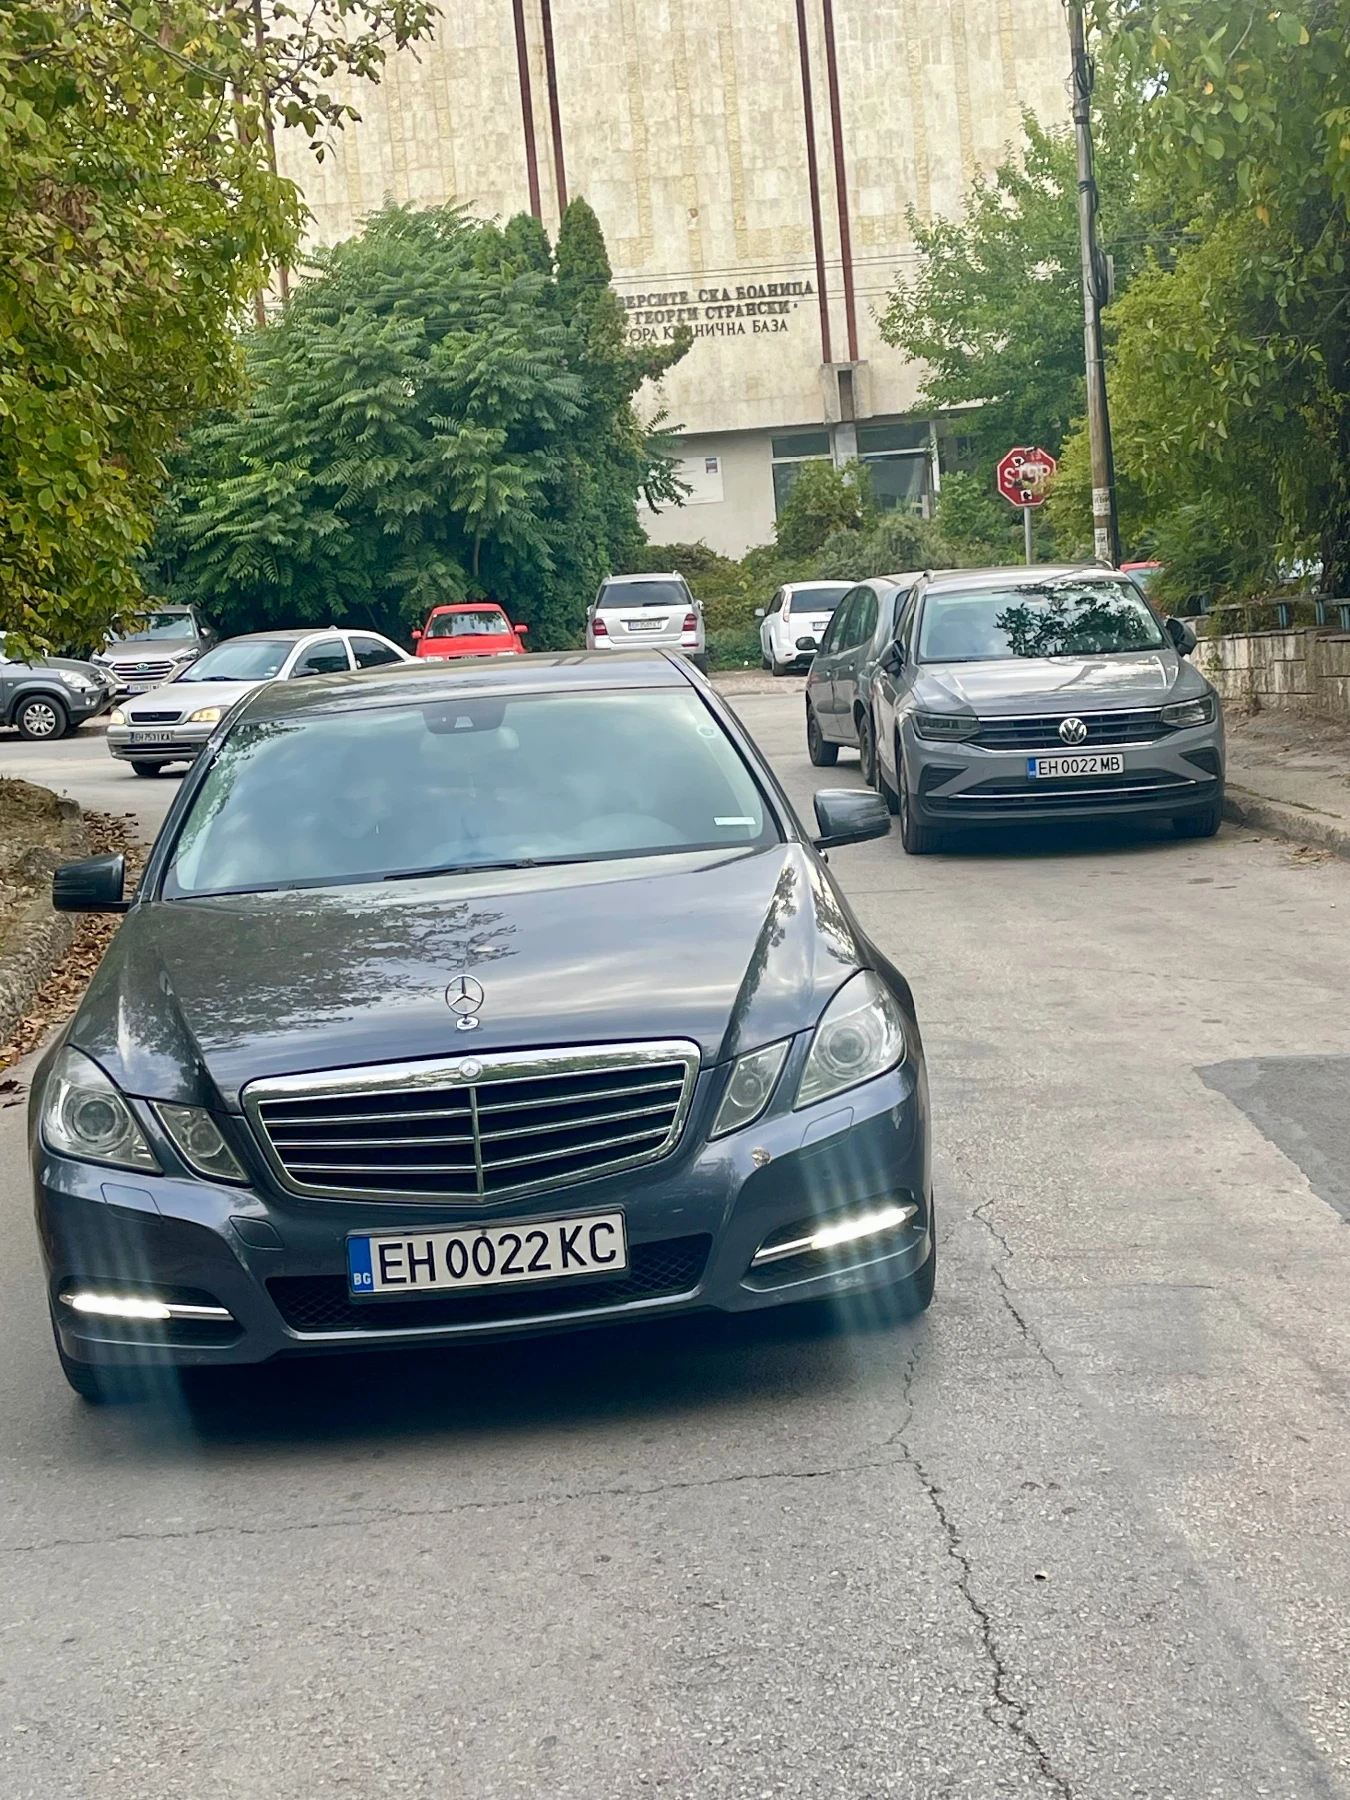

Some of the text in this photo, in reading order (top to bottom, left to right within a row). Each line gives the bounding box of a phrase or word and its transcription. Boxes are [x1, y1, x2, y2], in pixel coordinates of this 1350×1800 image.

[735, 280, 814, 300] БОЛНИЦА
[635, 307, 699, 325] ГЕОРГИ
[753, 318, 789, 334] БАЗА
[354, 1272, 371, 1285] BG
